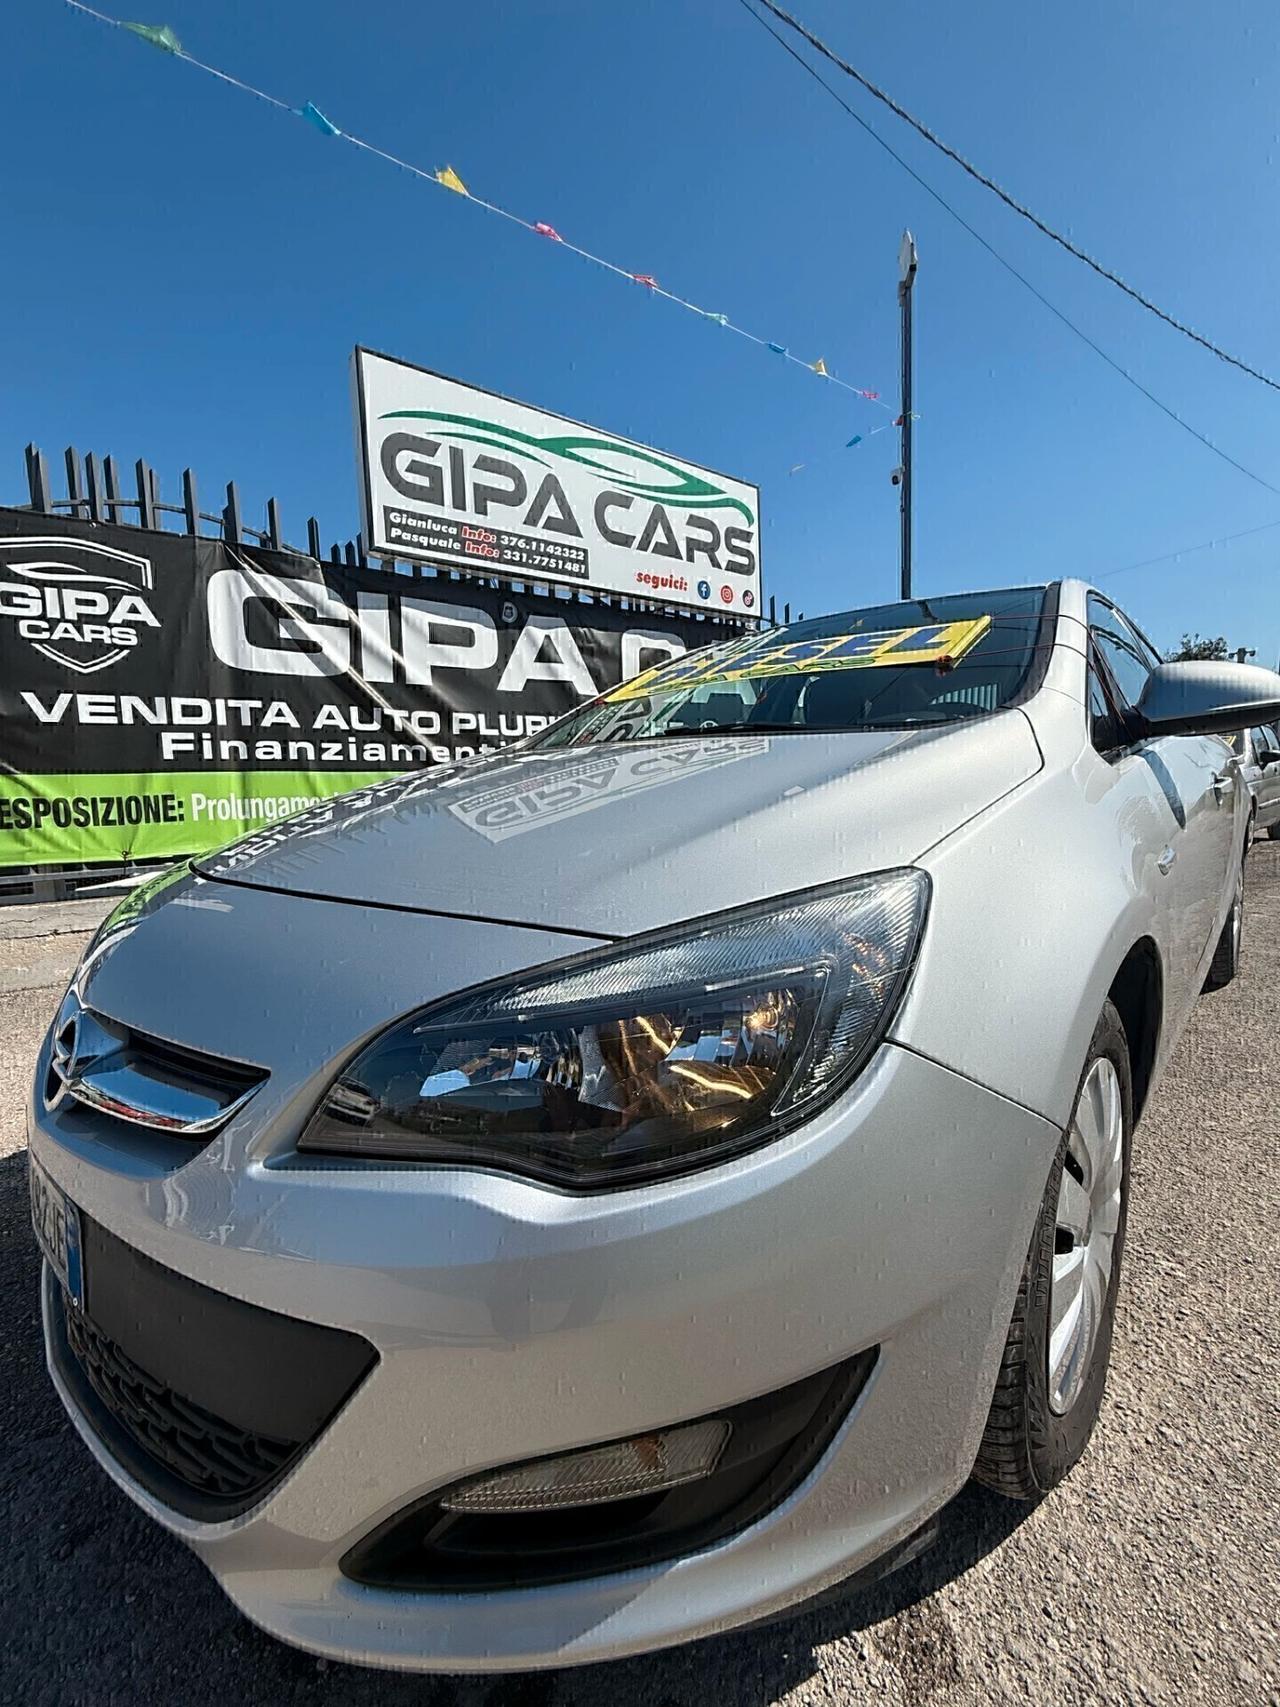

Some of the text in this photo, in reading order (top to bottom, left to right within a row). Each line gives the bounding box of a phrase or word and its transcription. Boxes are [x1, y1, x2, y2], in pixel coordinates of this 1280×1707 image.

[380, 432, 755, 576] GIPA CARS
[389, 512, 585, 561] Gianluca Info: 376.1142322
[391, 527, 586, 574] Pasquale Info: 331.7751481
[636, 571, 688, 591] seguici:
[0, 582, 161, 628] GIPA
[18, 619, 138, 646] CARS
[207, 569, 598, 697] GIPA
[20, 691, 300, 728] VENDITA
[312, 704, 441, 735] AUTO
[452, 711, 562, 738] PLUR
[0, 794, 185, 831] ESPOSIZIONE:
